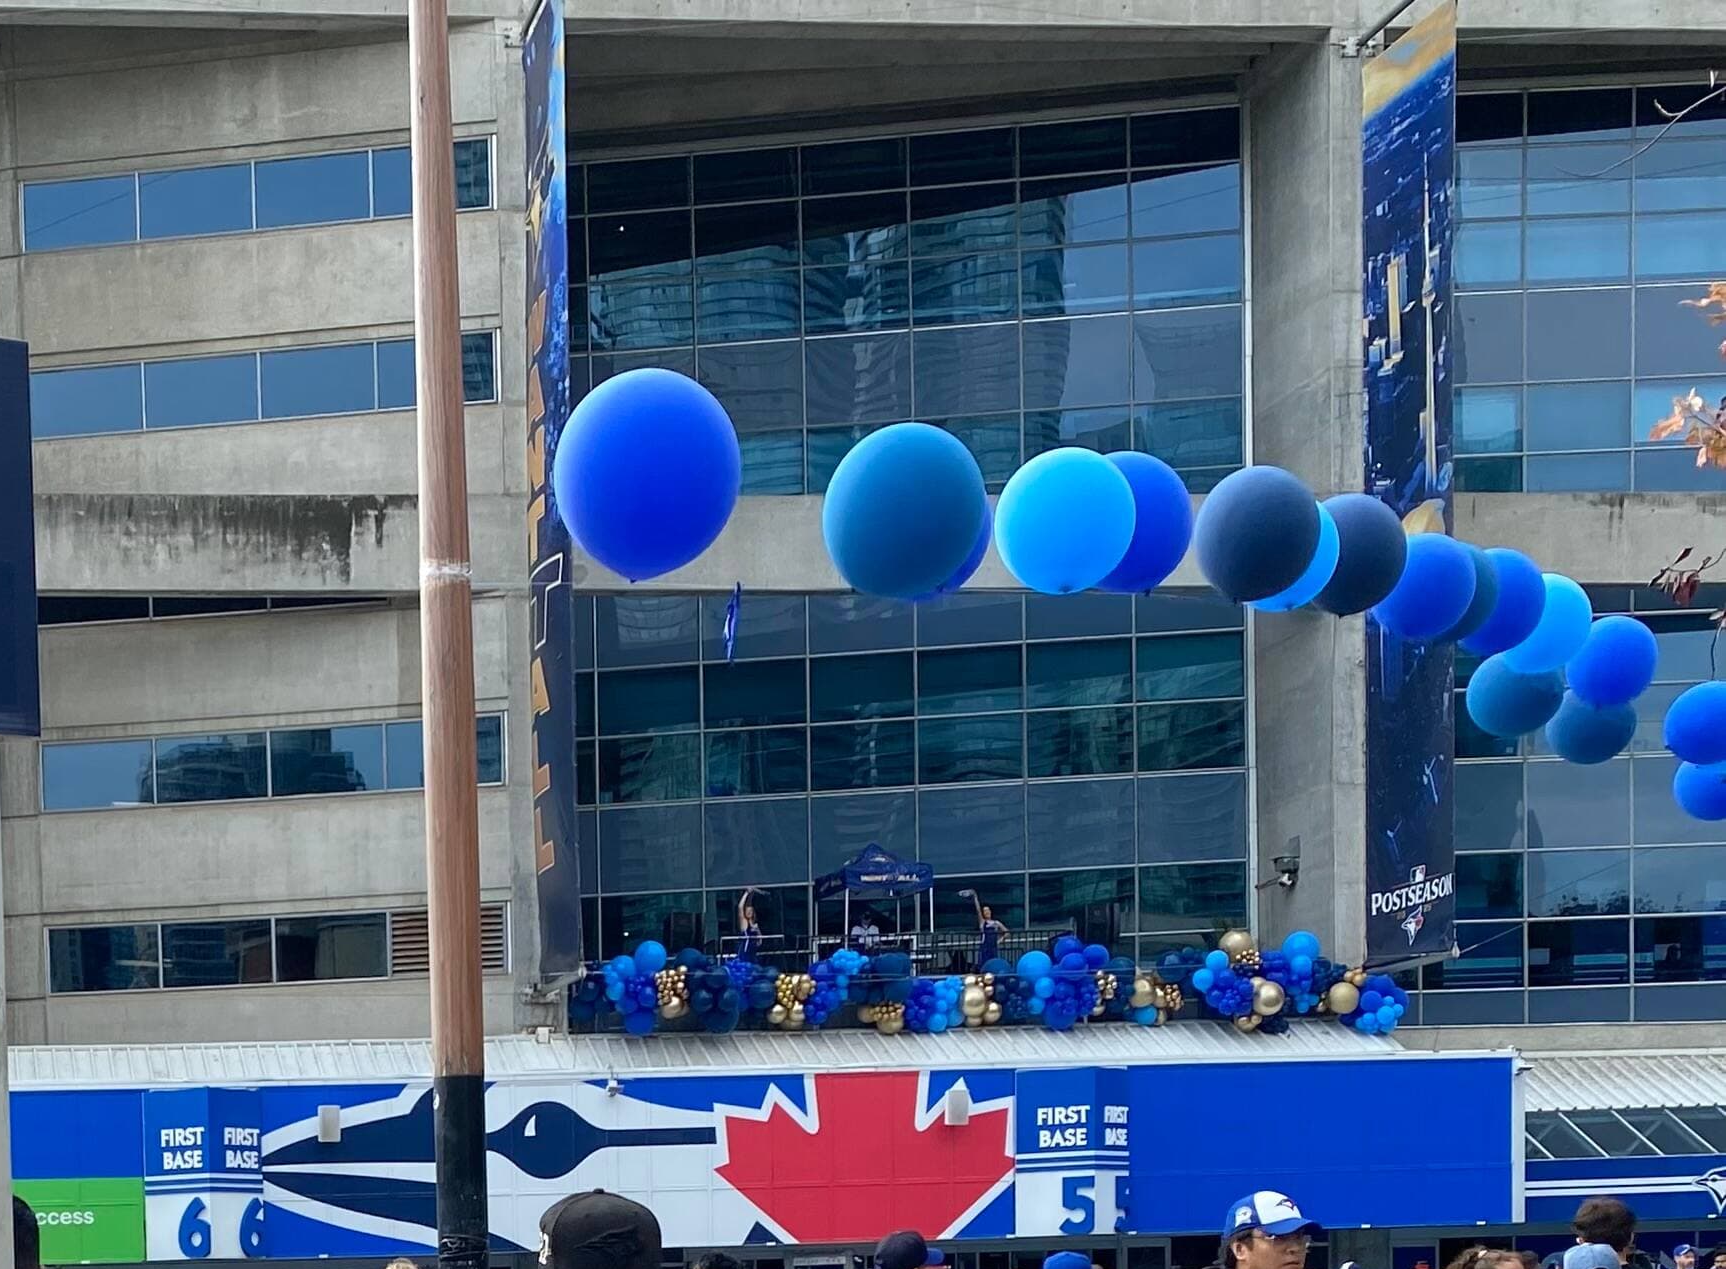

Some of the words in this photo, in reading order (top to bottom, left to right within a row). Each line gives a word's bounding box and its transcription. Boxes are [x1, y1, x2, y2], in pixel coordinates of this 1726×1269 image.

[1371, 873, 1453, 916] POSTSEASON
[1037, 1105, 1091, 1126] FIRST
[160, 1127, 205, 1147] FIRST
[223, 1127, 260, 1146] FIRST
[1039, 1128, 1088, 1148] BASE
[163, 1150, 203, 1170] BASE
[225, 1150, 259, 1169] BASE
[1058, 1175, 1096, 1235] 5
[35, 1211, 95, 1226] ccess
[178, 1196, 212, 1259] 6
